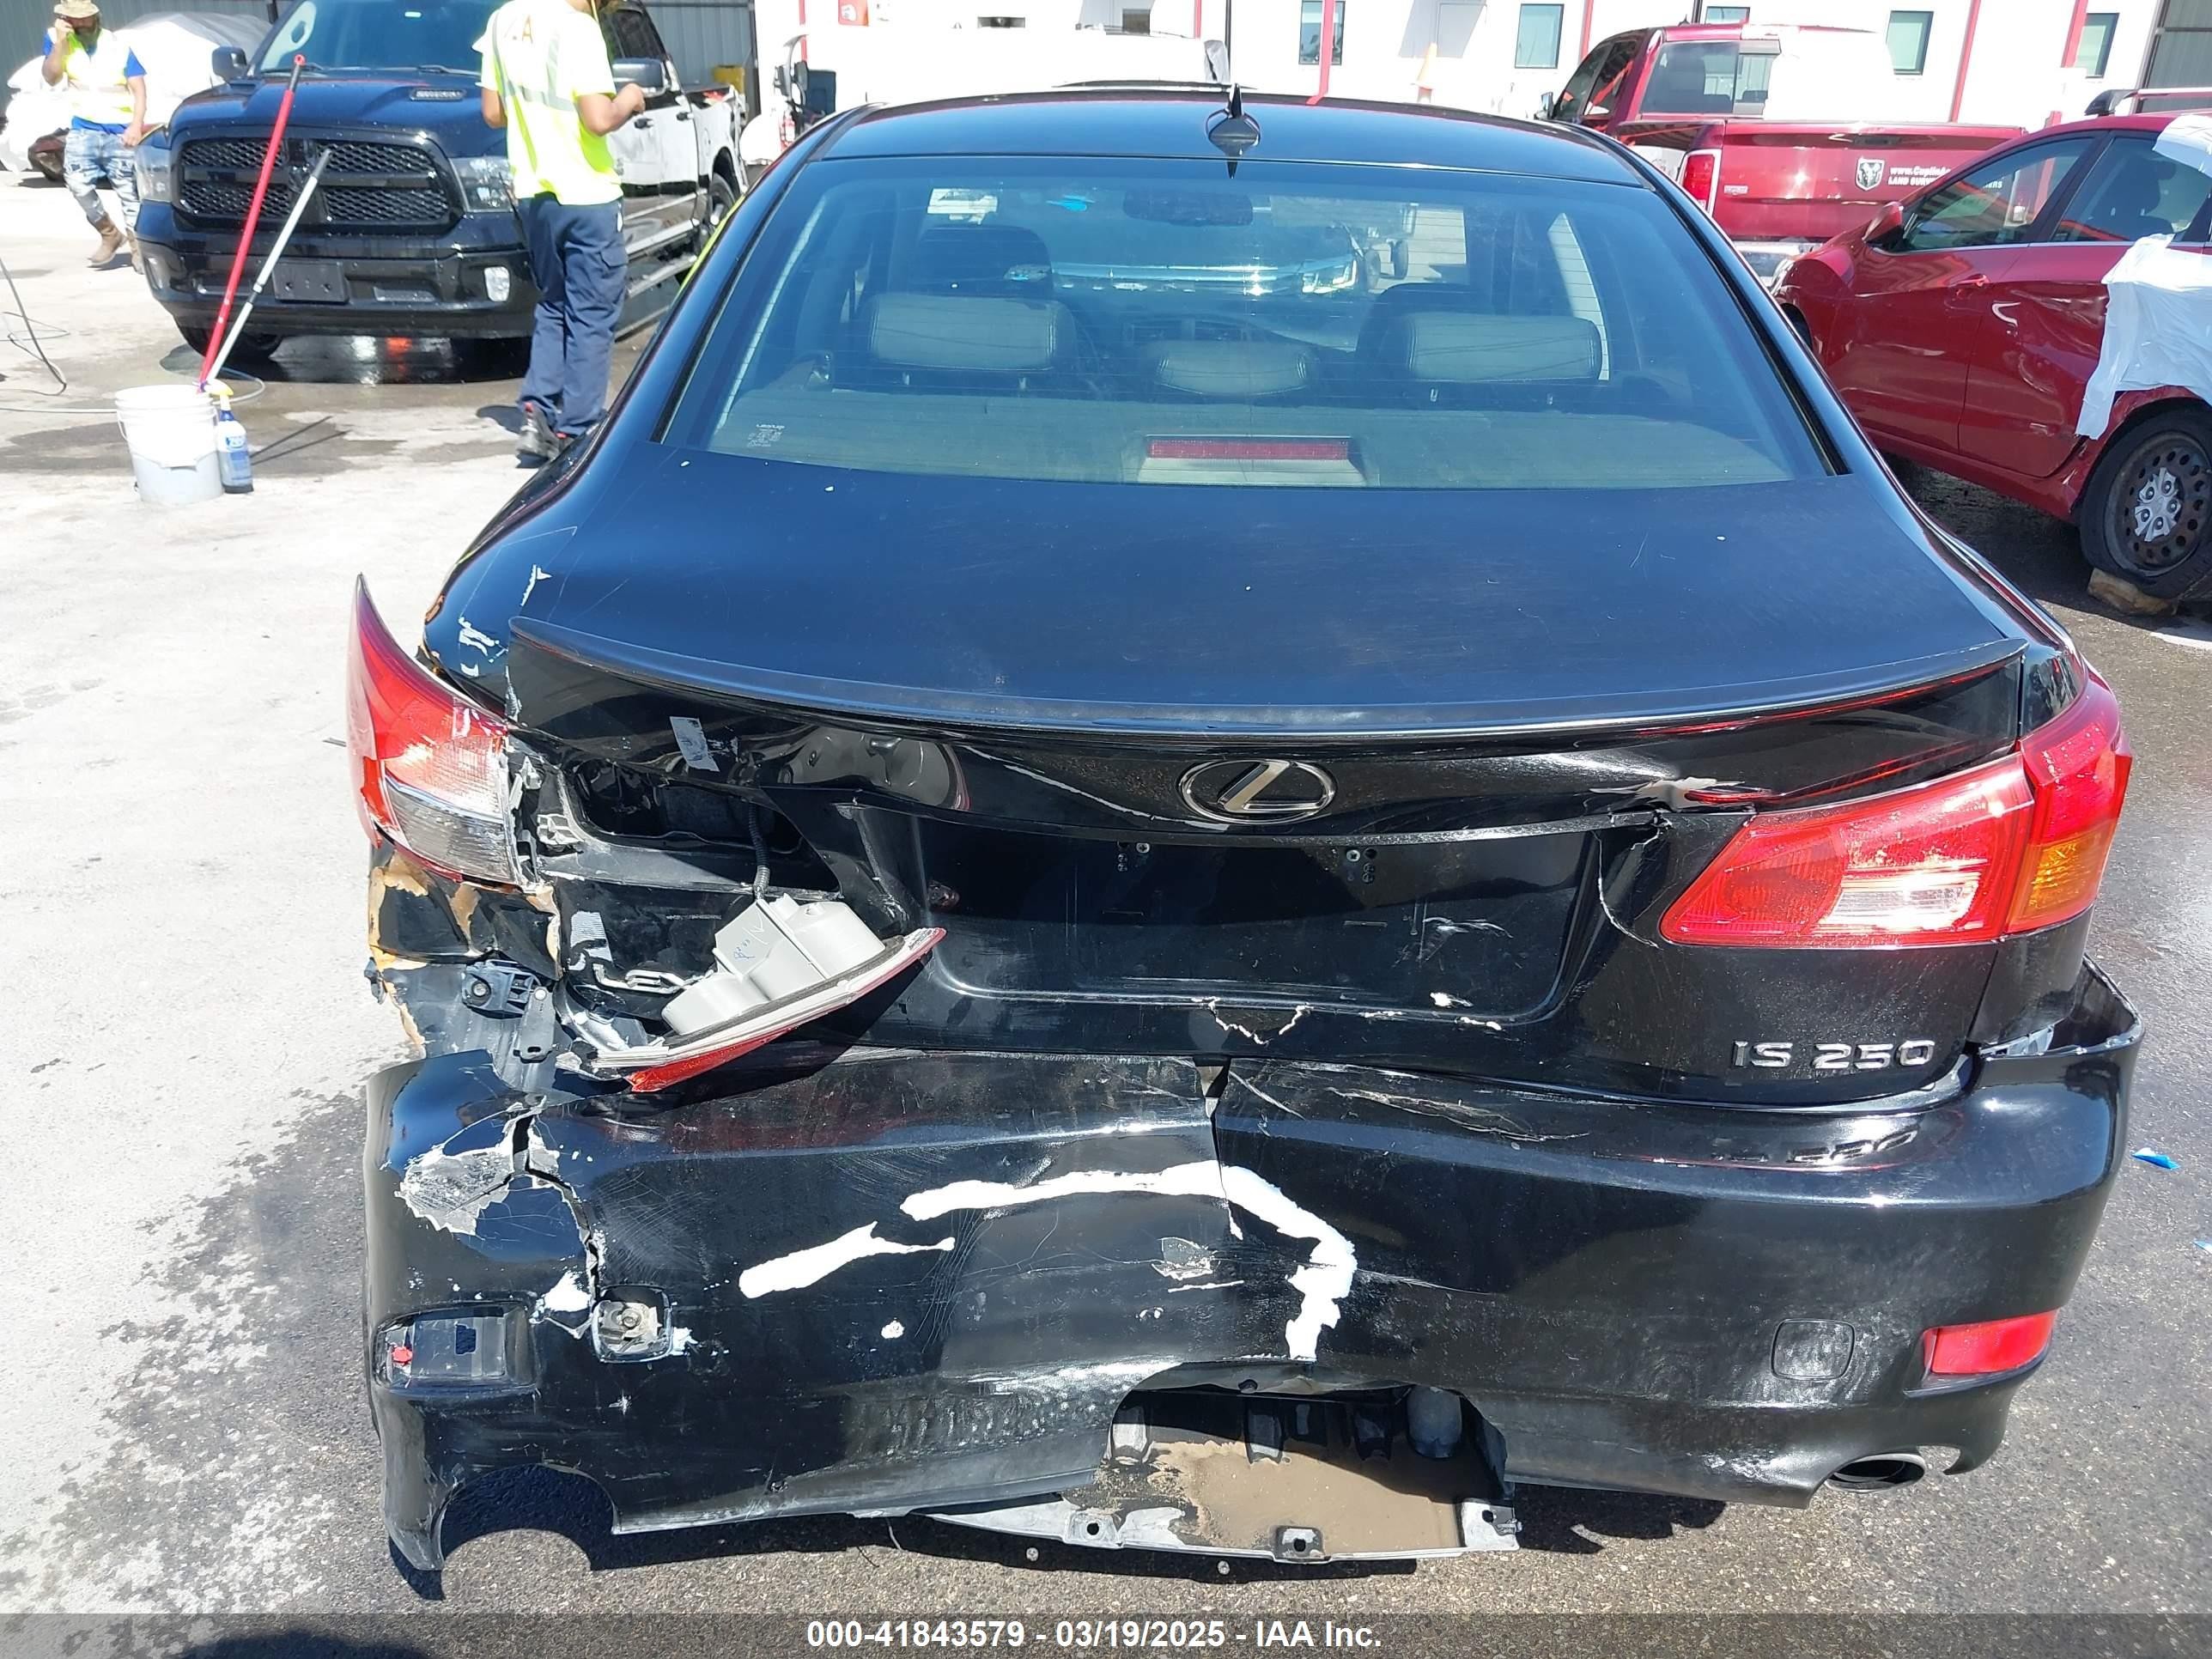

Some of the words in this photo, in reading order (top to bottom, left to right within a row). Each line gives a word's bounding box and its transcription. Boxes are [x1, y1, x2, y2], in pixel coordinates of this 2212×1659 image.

[1888, 176, 1910, 185] LAND
[1733, 1040, 1793, 1067] IS
[1812, 1039, 1936, 1069] 250
